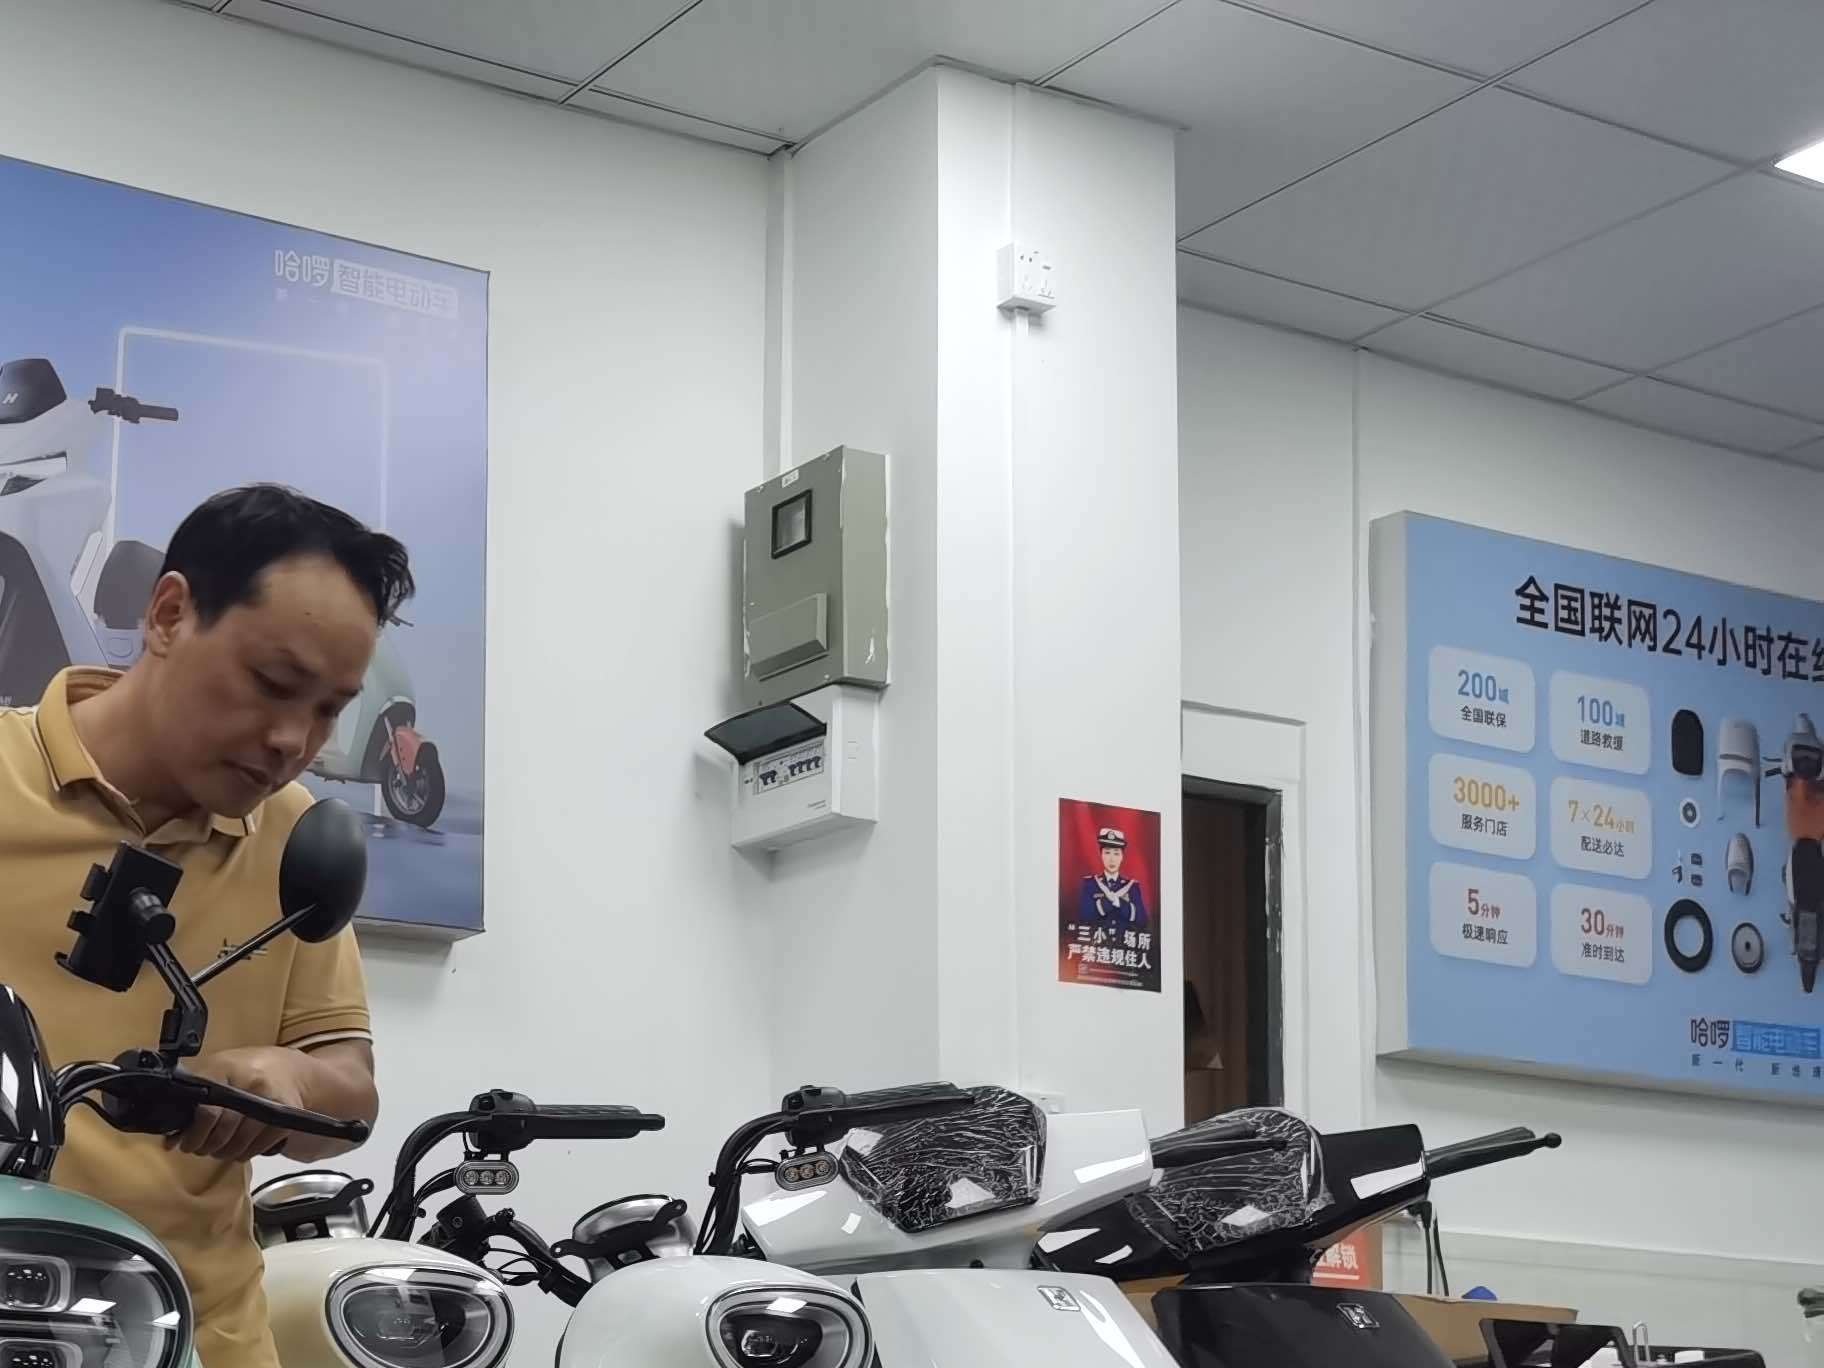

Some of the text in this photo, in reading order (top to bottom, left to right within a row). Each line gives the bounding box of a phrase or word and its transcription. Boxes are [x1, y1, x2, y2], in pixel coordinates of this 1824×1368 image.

[1460, 705, 1507, 729] 全国联保
[1580, 729, 1624, 751] 道路救援
[1453, 776, 1520, 812] 3000+
[1461, 813, 1508, 837] 服务门店
[1580, 835, 1624, 858] 配送必达
[1462, 923, 1509, 945] 极速响应
[1067, 943, 1152, 969] 严禁违规住人
[1581, 942, 1625, 963] 准时到达
[1690, 1017, 1730, 1048] 哈啰
